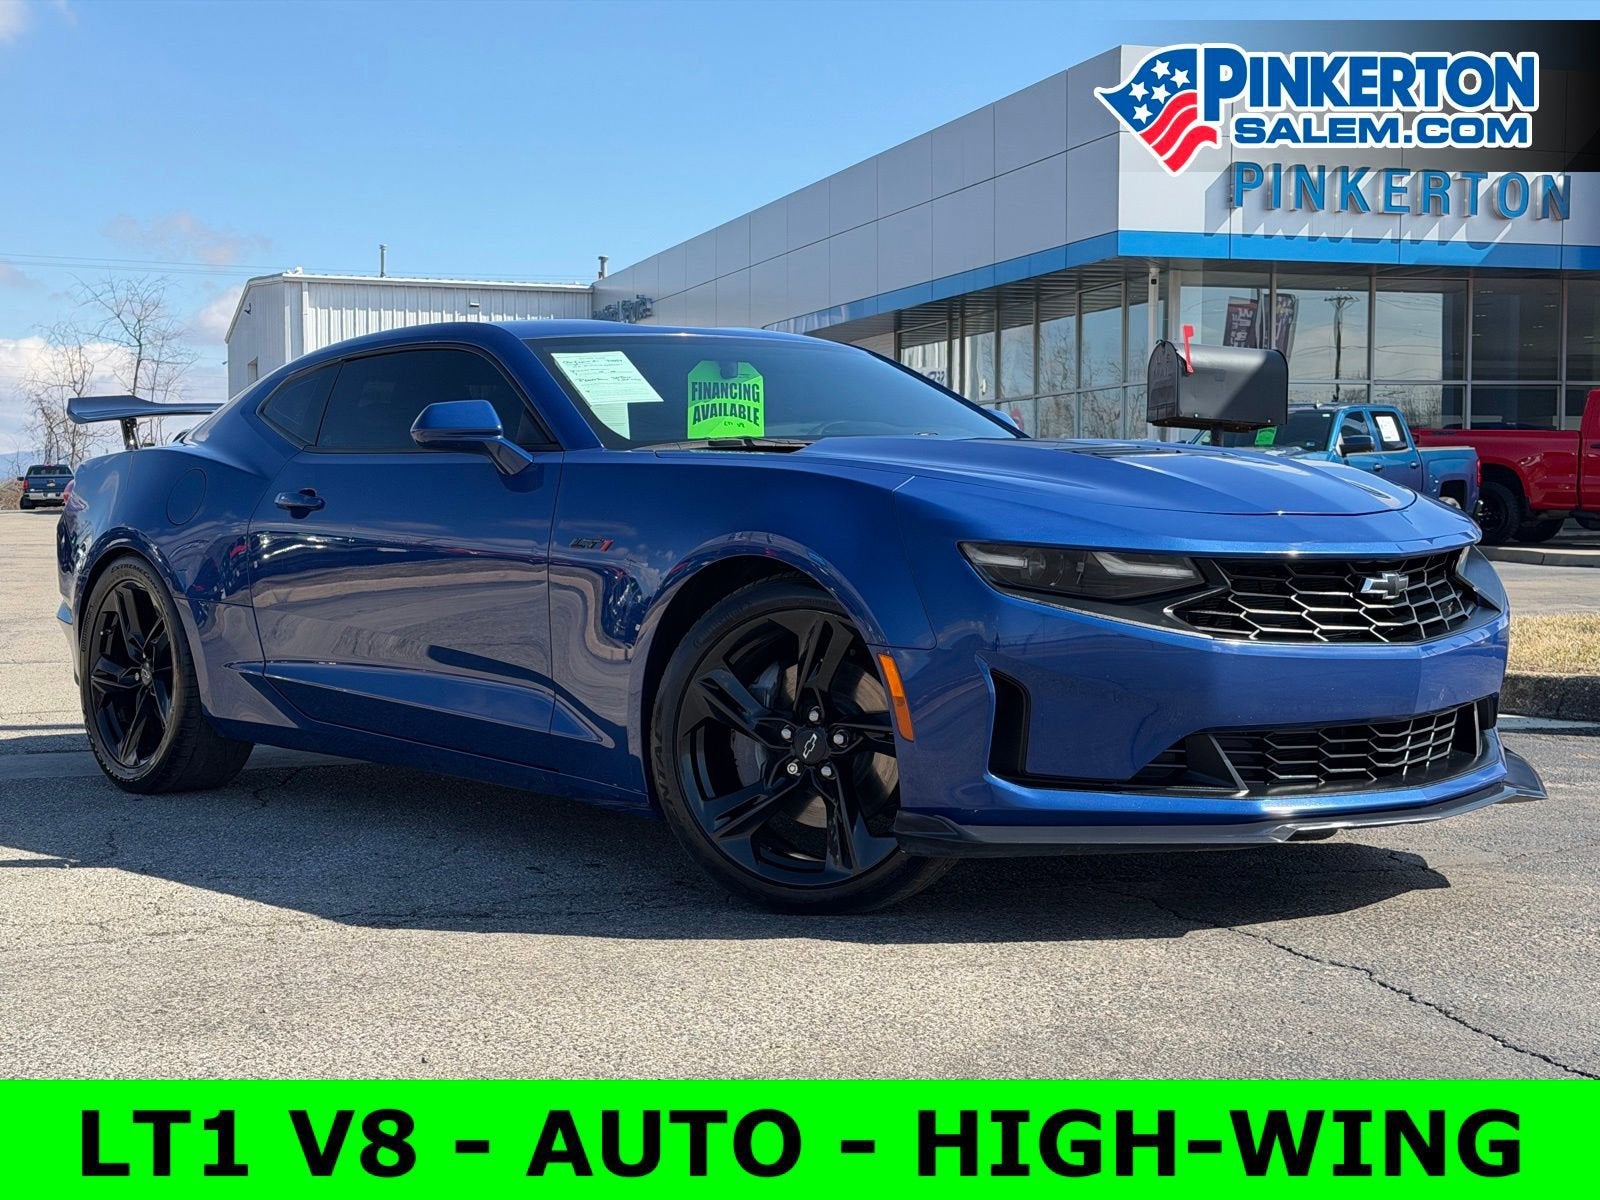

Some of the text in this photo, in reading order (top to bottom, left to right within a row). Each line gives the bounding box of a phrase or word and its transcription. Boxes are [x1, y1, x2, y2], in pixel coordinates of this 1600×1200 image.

[1230, 160, 1572, 221] PINKERTON
[691, 381, 760, 403] FINANCING
[692, 402, 760, 427] AVAILABLE
